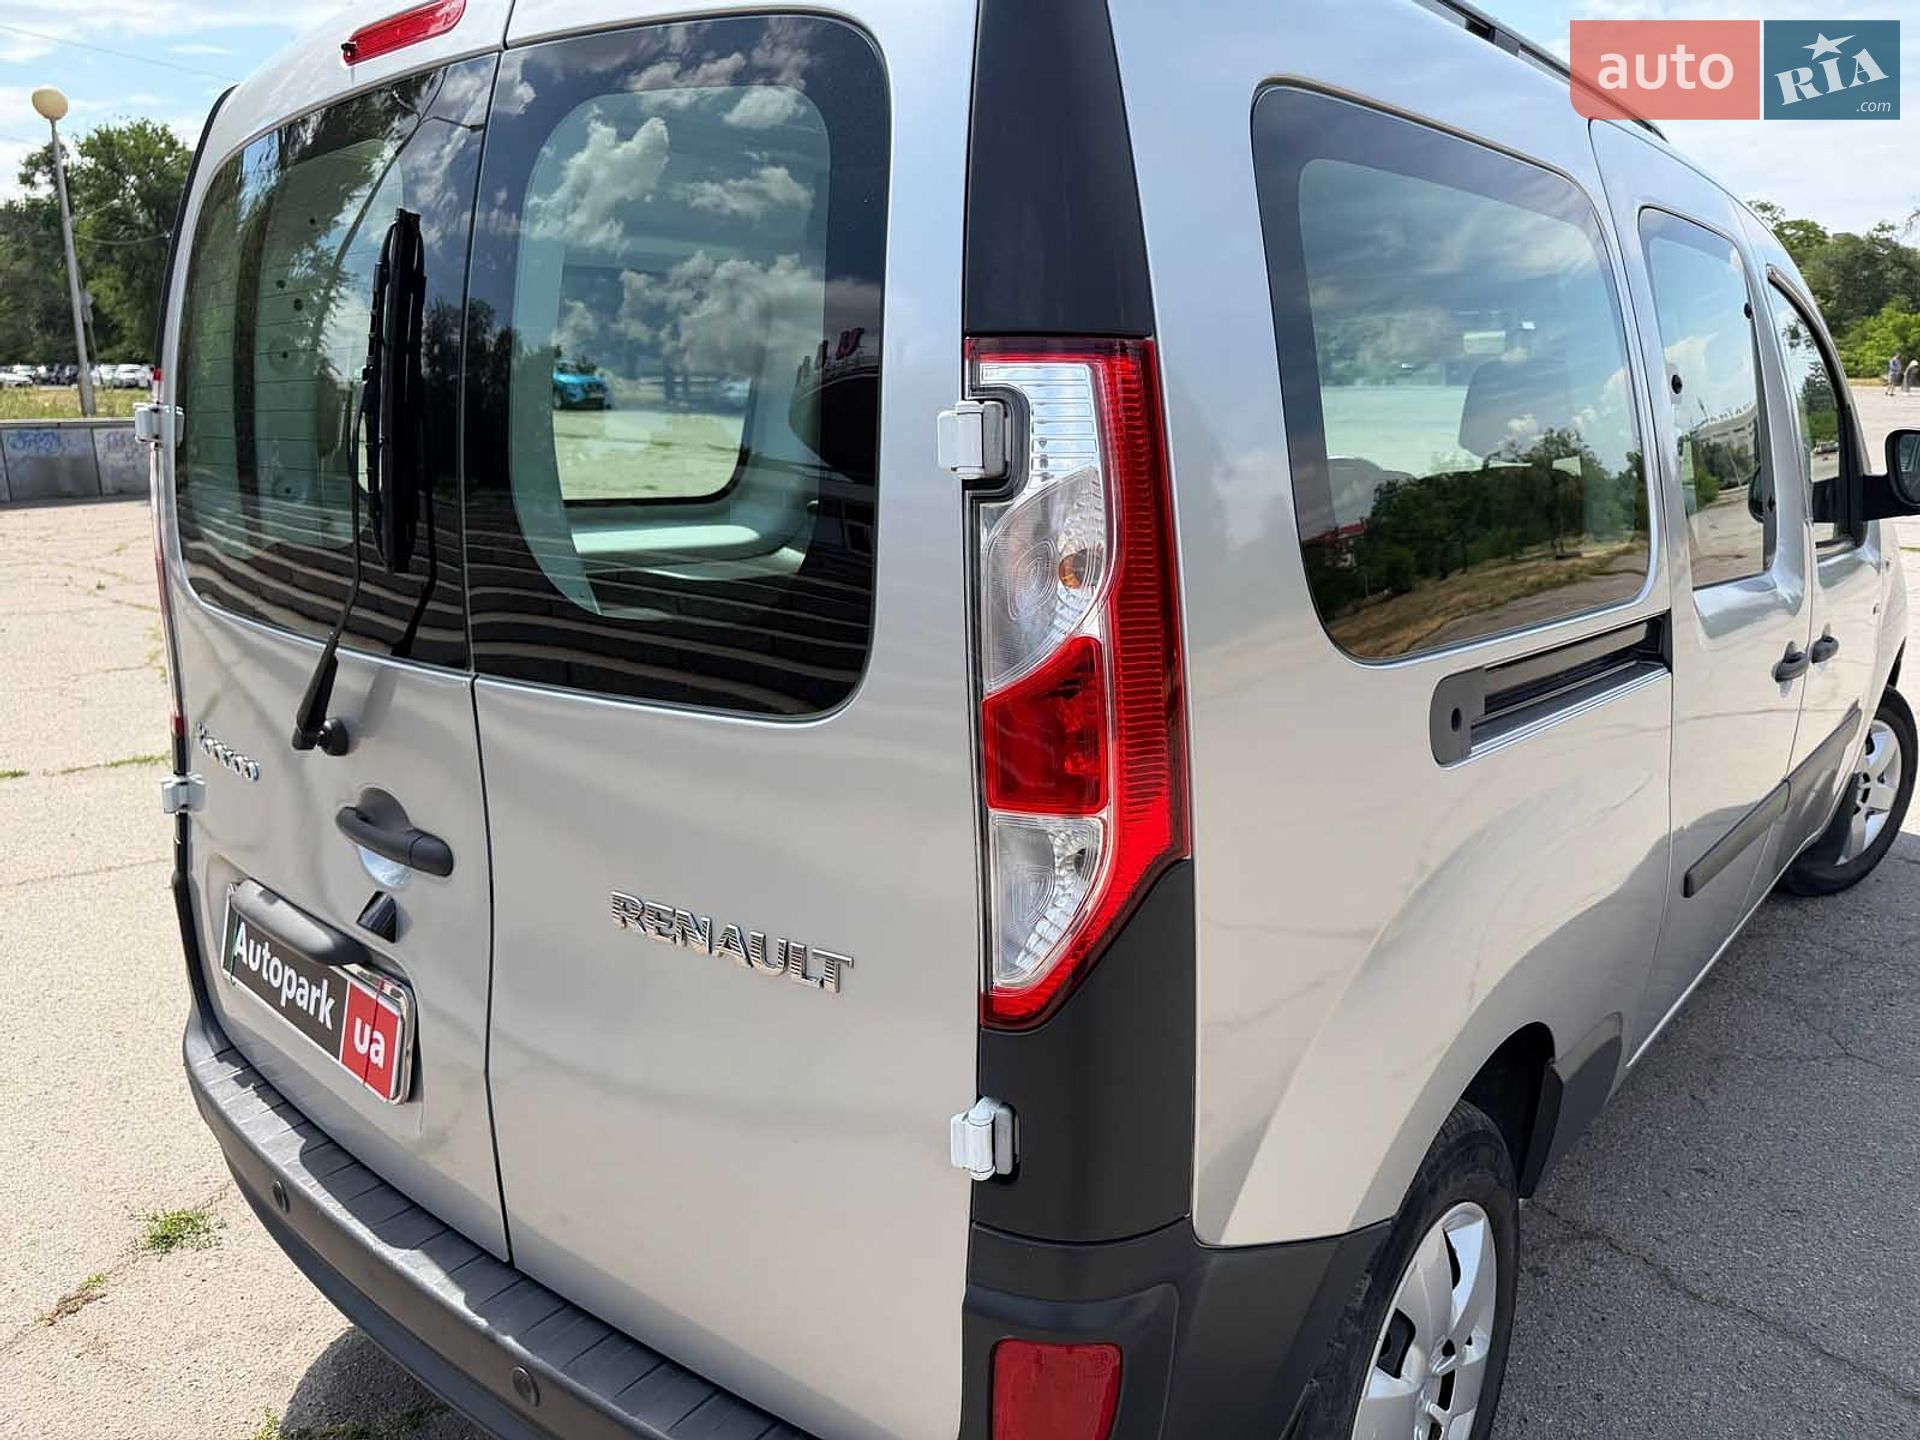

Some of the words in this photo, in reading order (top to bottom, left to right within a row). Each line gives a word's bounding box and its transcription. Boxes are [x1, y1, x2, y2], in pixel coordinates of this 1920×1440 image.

[233, 921, 335, 1030] Autopark
[353, 1017, 385, 1069] ua
[610, 889, 854, 994] RENAULT
